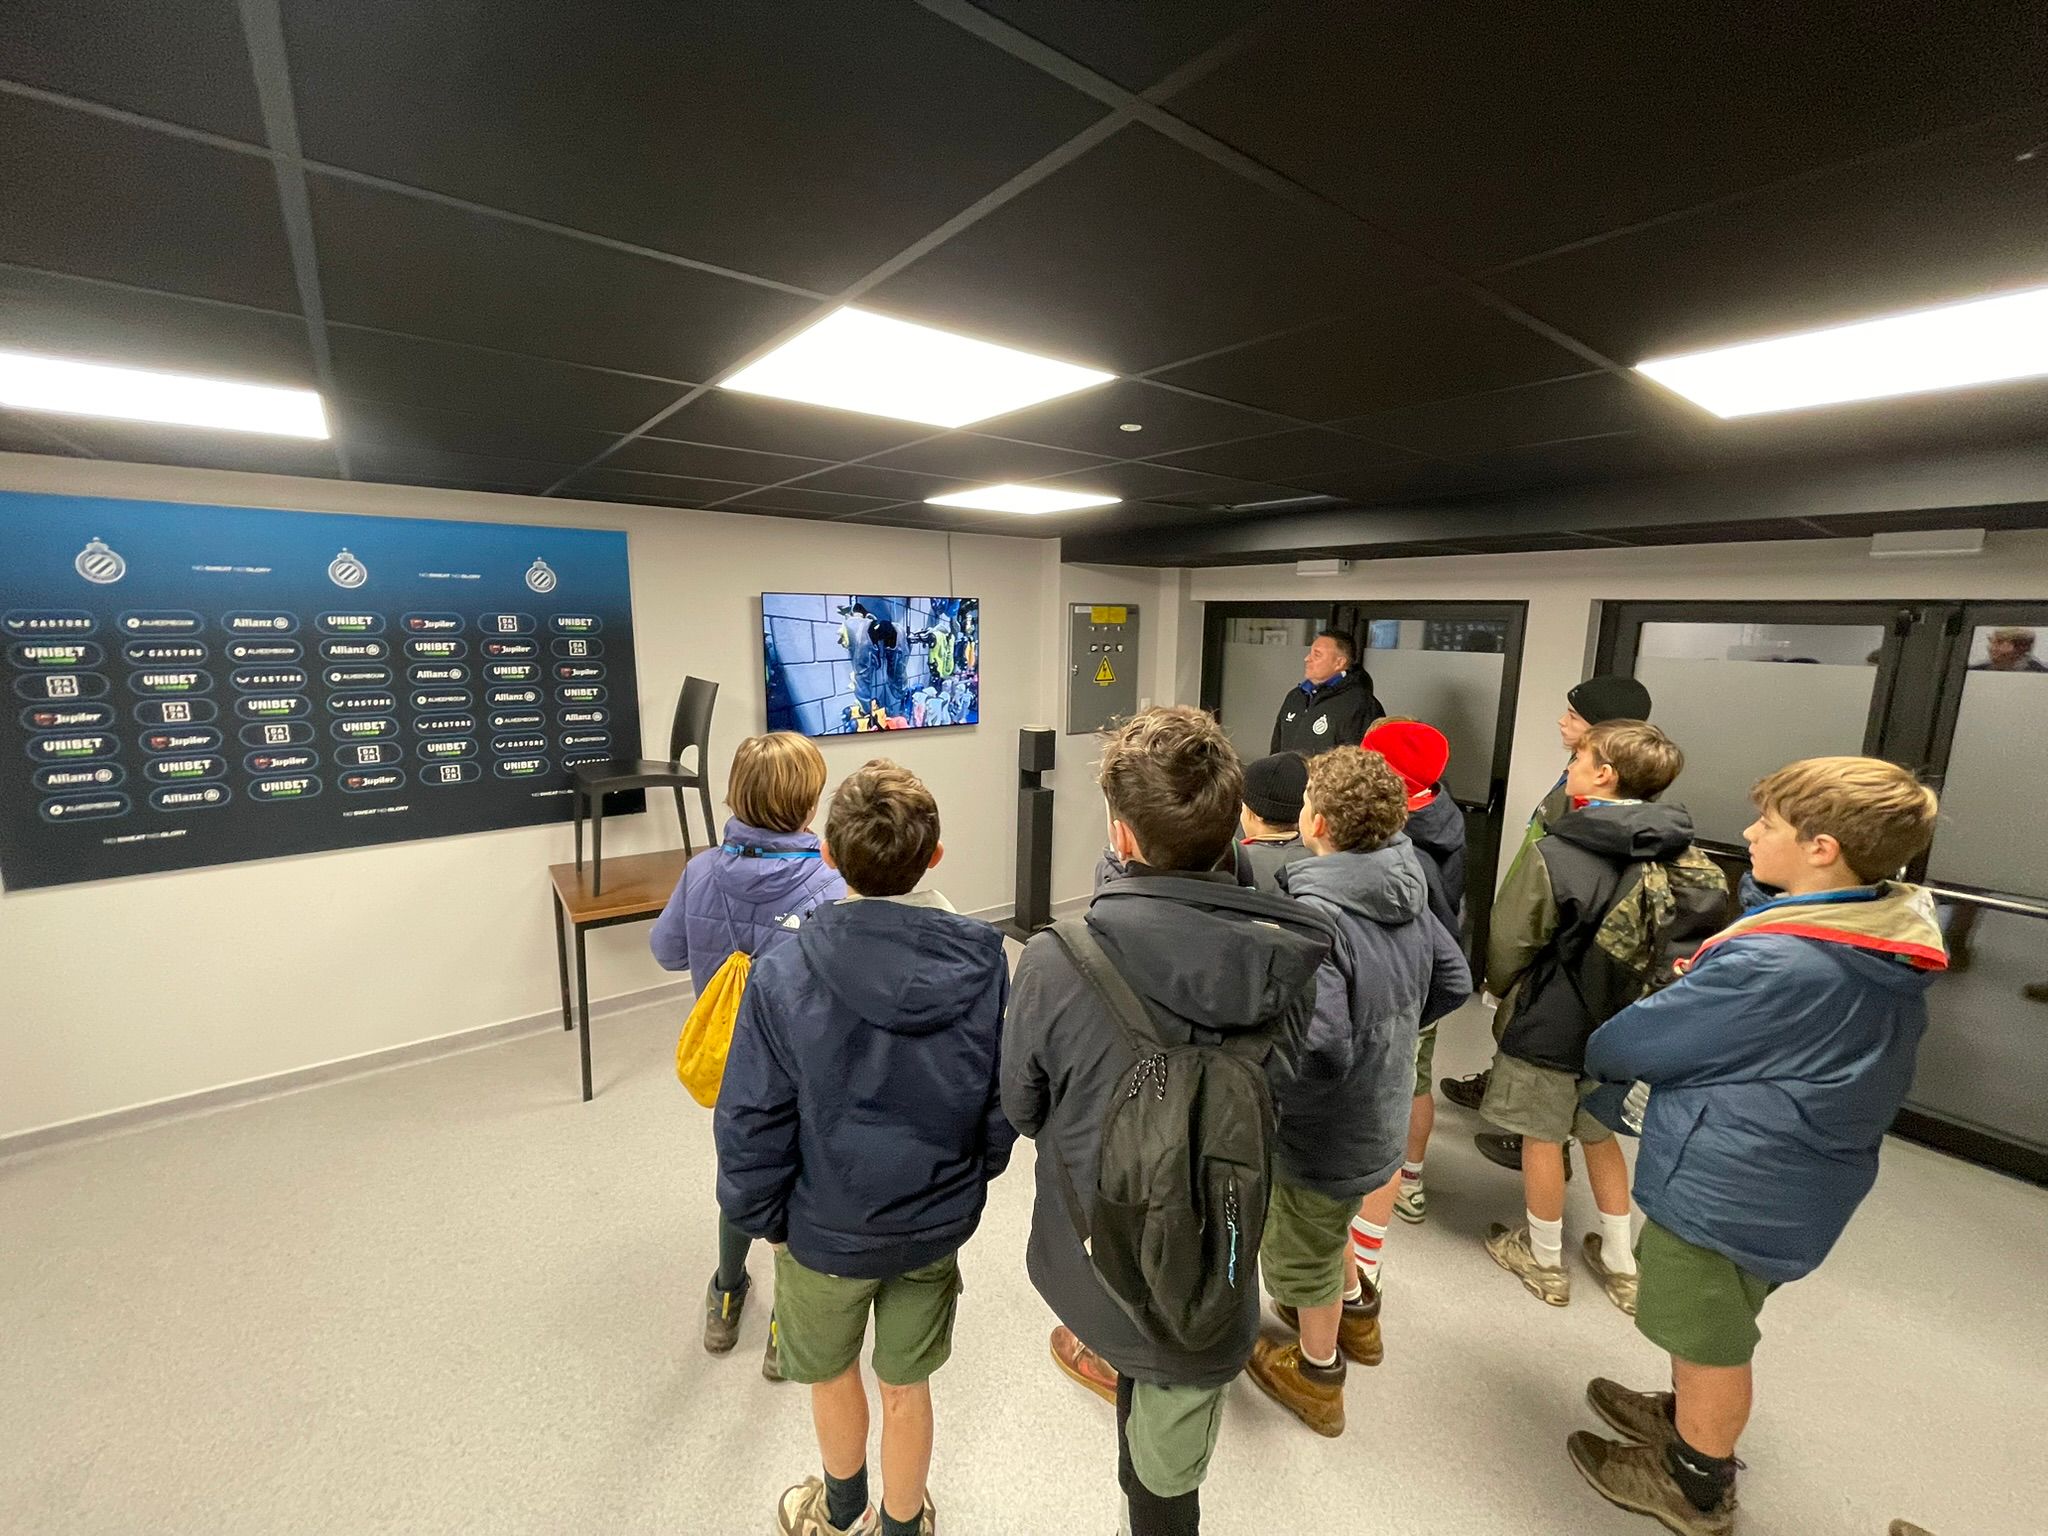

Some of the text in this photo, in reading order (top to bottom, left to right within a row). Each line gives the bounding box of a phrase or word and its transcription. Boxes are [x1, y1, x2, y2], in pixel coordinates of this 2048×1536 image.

[30, 619, 91, 628] CASTORE
[233, 618, 272, 628] Allianz
[328, 616, 373, 626] UNIBET
[423, 620, 456, 629] Jupiler
[558, 618, 593, 627] UNIBET
[330, 646, 366, 655] Allianz
[415, 642, 457, 651] UNIBET
[501, 645, 532, 654] Jupiler
[24, 646, 86, 658] UNIBET
[148, 649, 203, 658] CASTORE
[416, 670, 449, 679] Allianz
[493, 666, 531, 675] UNIBET
[571, 668, 599, 677] Jupiler
[143, 674, 198, 685] UNIBET
[253, 675, 302, 683] CASTORE
[564, 688, 599, 697] UNIBET
[494, 693, 524, 702] Allianz
[248, 699, 297, 710] UNIBET
[347, 699, 391, 707] CASTORE
[55, 712, 102, 725] Jupiler
[565, 713, 592, 722] Allianz
[342, 720, 387, 732] UNIBET
[432, 720, 471, 729] CASTORE
[43, 738, 103, 751] UNIBET
[169, 736, 211, 748] Jupiler
[508, 740, 544, 748] CASTORE
[427, 741, 468, 753] UNIBET
[159, 759, 212, 773] UNIBET
[270, 756, 309, 768] Jupiler
[503, 760, 540, 771] UNIBET
[48, 772, 94, 785] Allianz
[362, 775, 397, 787] Jupiler
[261, 779, 309, 792] UNIBET
[162, 792, 203, 804] Allianz
